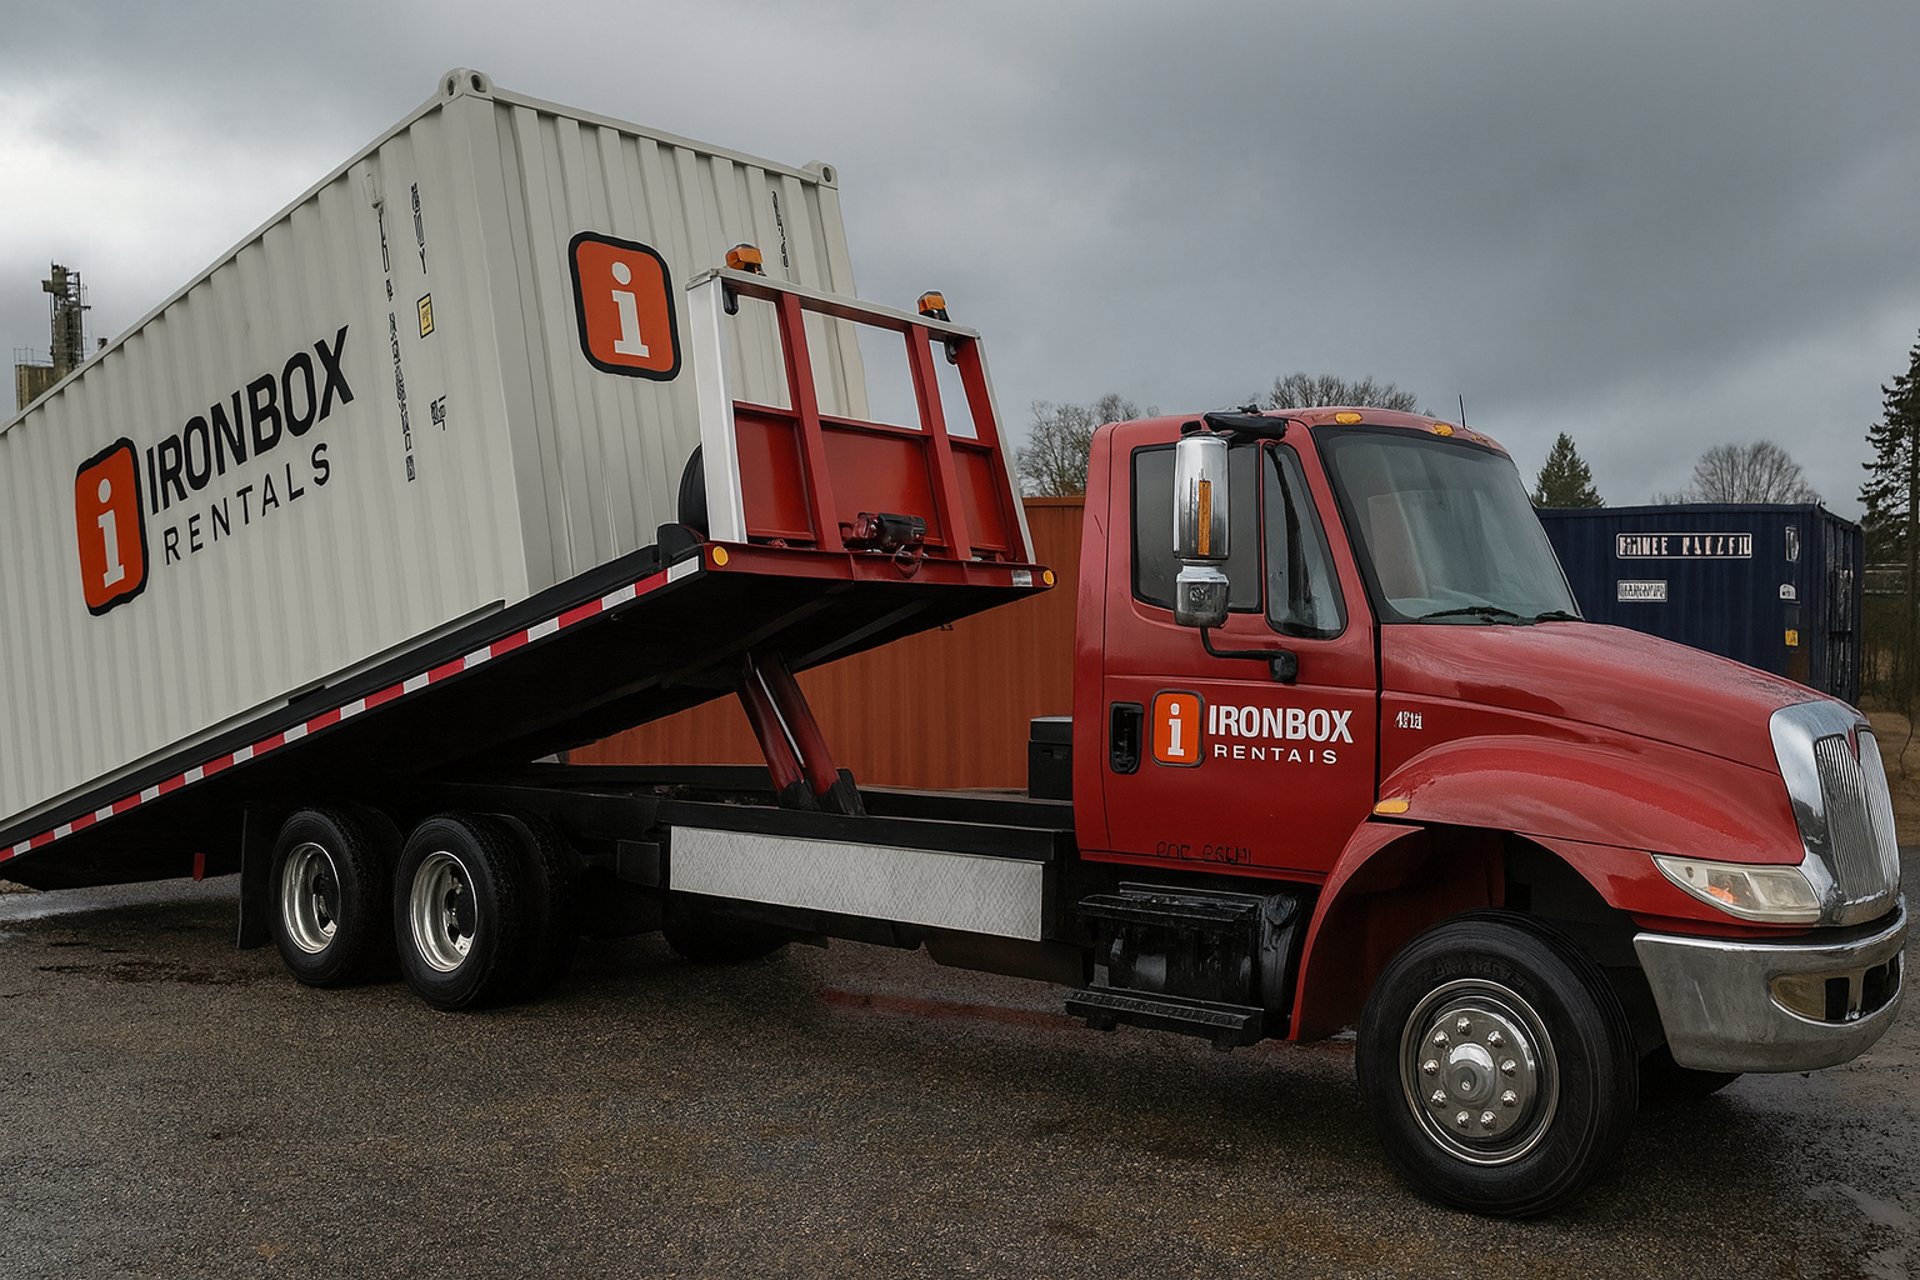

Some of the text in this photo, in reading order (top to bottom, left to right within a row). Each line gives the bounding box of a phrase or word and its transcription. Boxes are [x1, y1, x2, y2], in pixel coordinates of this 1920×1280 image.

[145, 324, 355, 516] IRONBOX
[163, 442, 330, 566] RENTALS
[1208, 704, 1354, 744] IRONBOX
